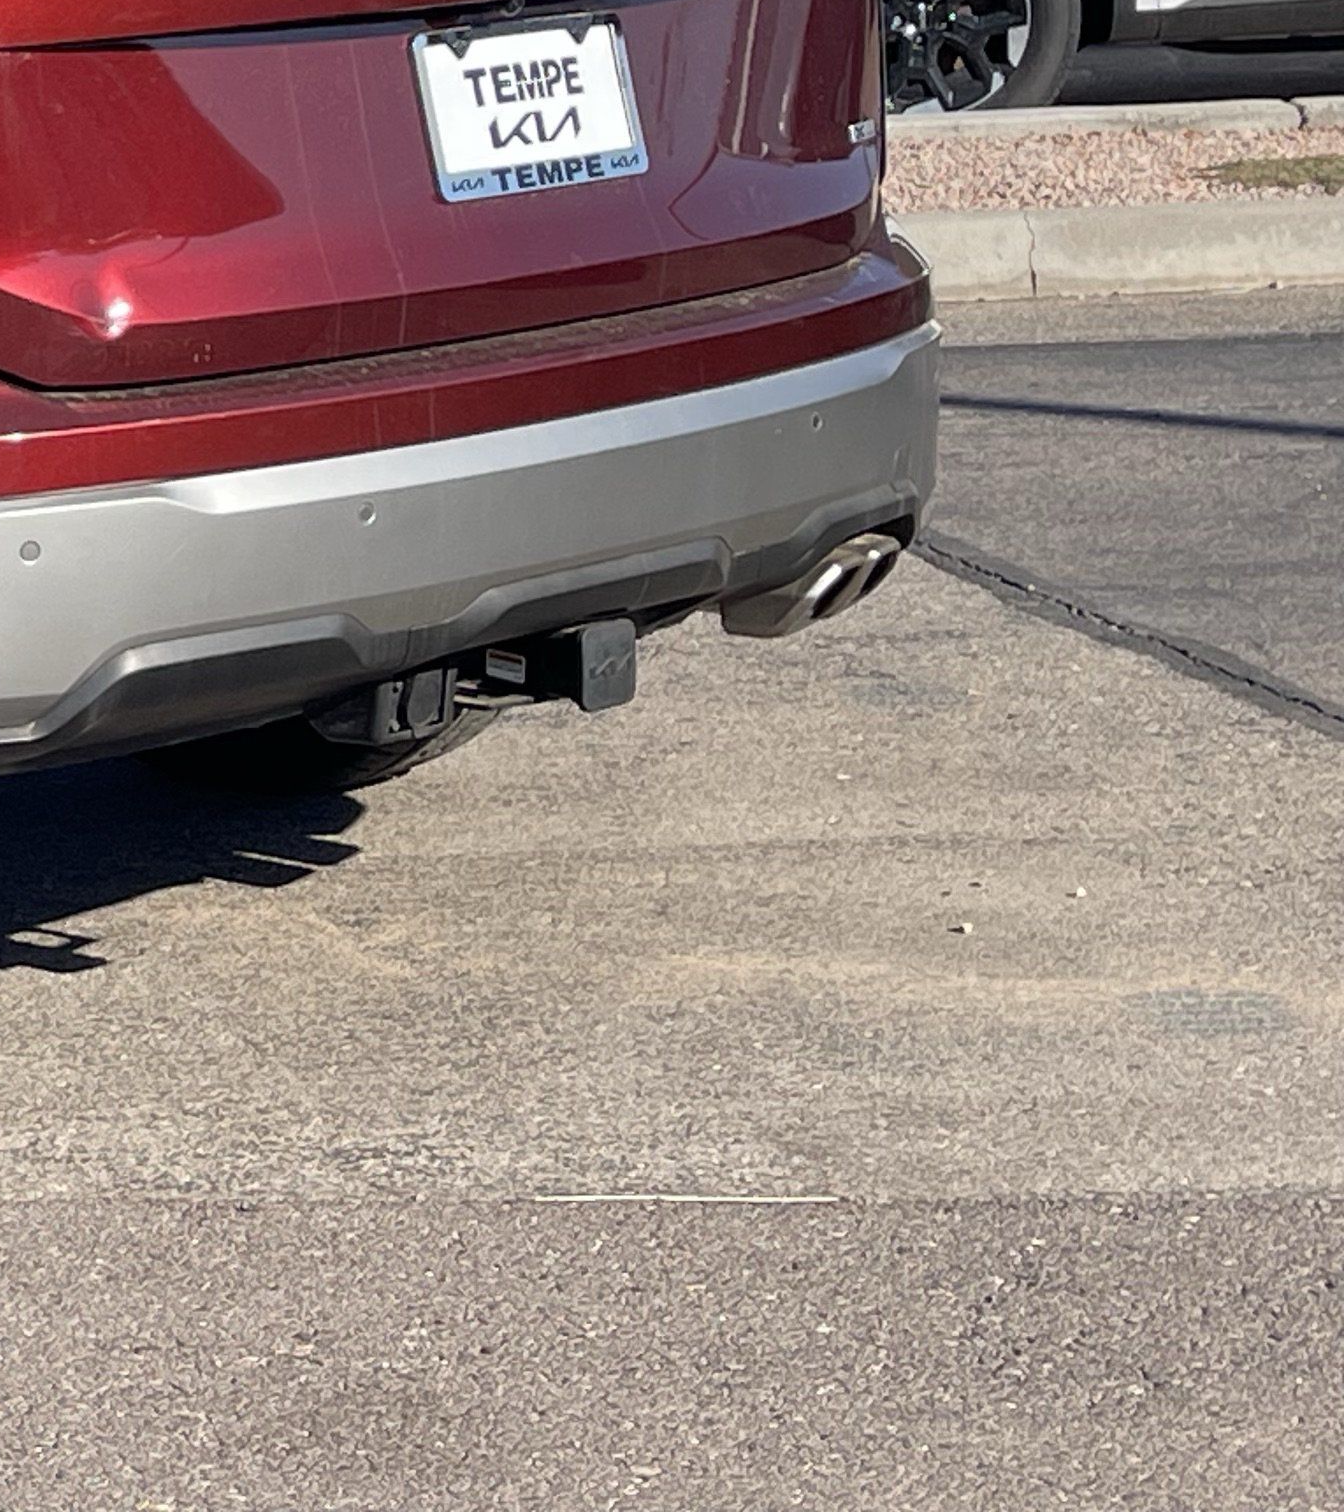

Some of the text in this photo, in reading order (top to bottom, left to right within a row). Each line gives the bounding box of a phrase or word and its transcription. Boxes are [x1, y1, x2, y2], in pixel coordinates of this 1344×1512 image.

[463, 56, 584, 107] TEMPE
[488, 106, 582, 149] KIA
[451, 153, 640, 193] KIA TEMPE KIA
